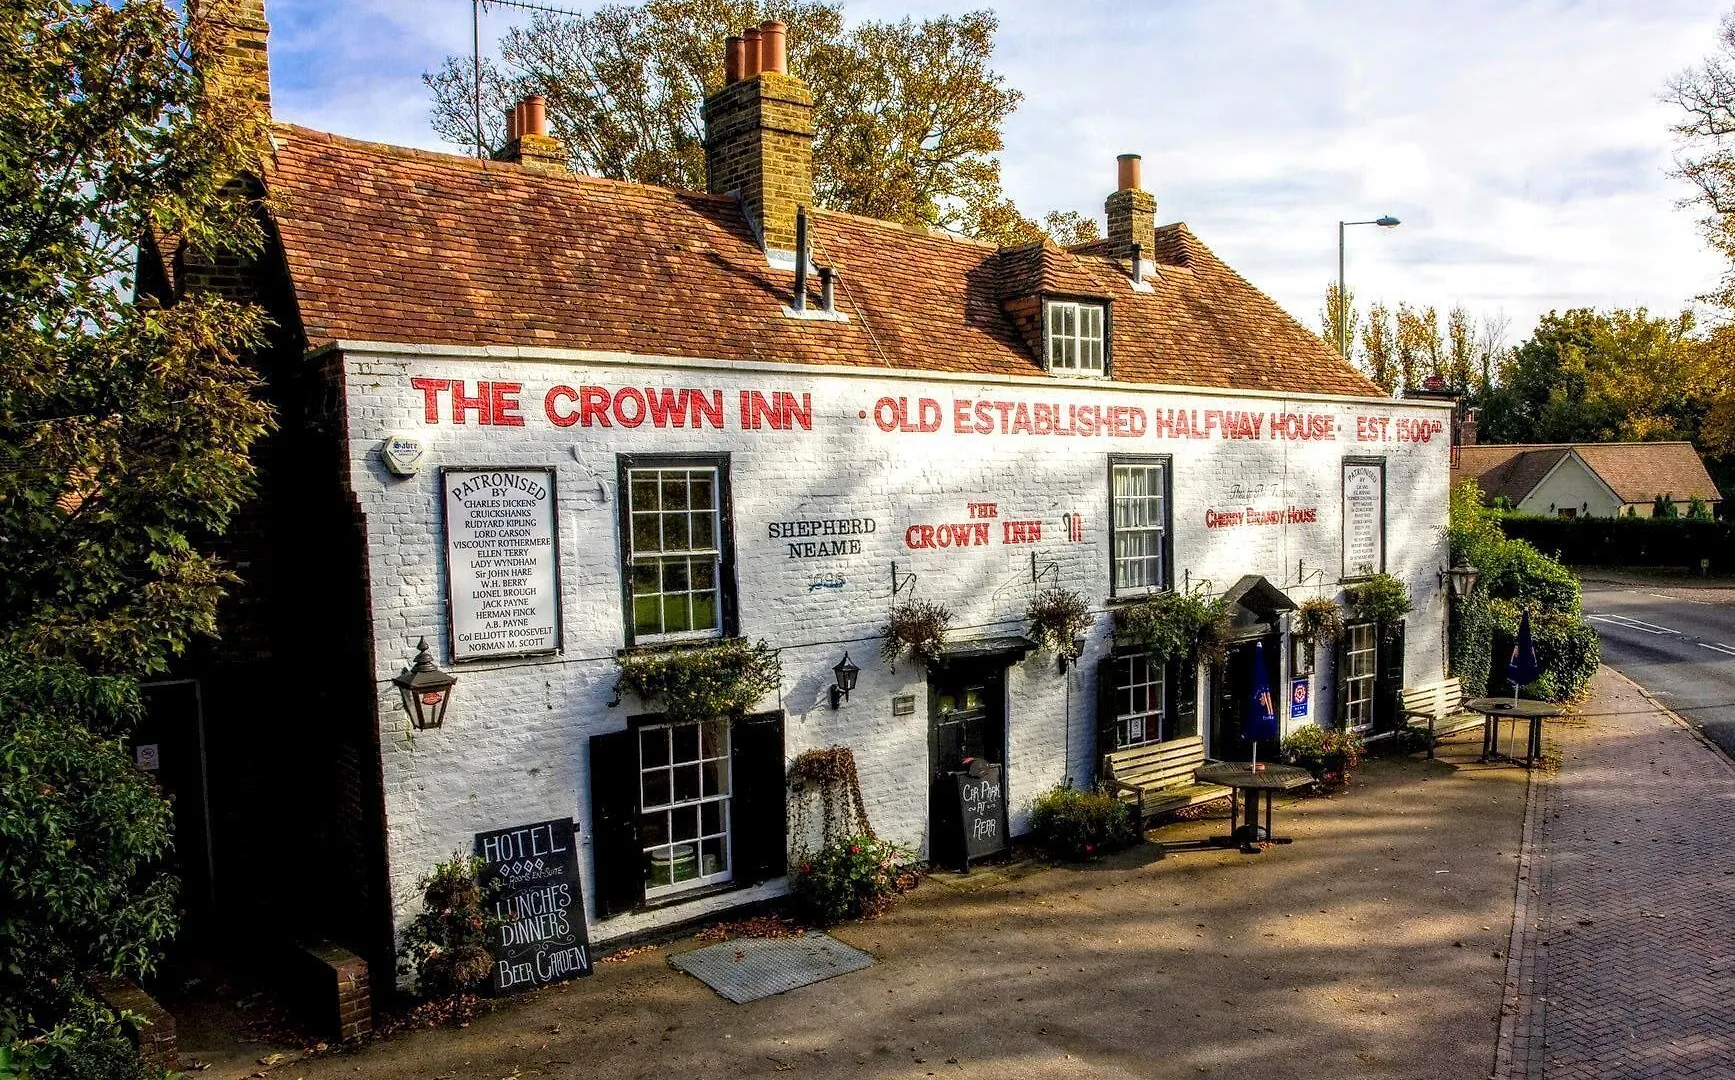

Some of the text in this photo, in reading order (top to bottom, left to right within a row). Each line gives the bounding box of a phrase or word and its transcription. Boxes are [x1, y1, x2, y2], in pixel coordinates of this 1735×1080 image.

[411, 377, 812, 431] THE CROWN INN
[874, 396, 943, 433] OLD
[953, 399, 1147, 437] ESTABLISHED
[1155, 407, 1266, 441] HALFWAY
[1270, 410, 1335, 442] HOUSE
[1357, 416, 1391, 442] EST.
[452, 473, 546, 501] PATRONISED
[492, 488, 508, 497] BY
[464, 499, 536, 509] CHARLES DICKENS
[470, 509, 531, 518] CRUICKSHANKS
[967, 502, 998, 519] THE
[1287, 505, 1317, 524] HOUSE
[465, 518, 537, 529] RUDYARD KIPLING
[768, 518, 876, 539] SHEPHERD
[474, 529, 531, 539] LORD CARSON
[905, 520, 1042, 549] CROWN INN
[453, 538, 551, 549] VISCOUNT ROTHERMERE
[788, 540, 861, 559] NEAME
[477, 549, 529, 558] ELLEN TERRY
[471, 558, 537, 568] LADY WYNDHAM
[488, 570, 509, 580] JOHN
[511, 568, 532, 577] HARE
[503, 578, 528, 587] BERRY
[472, 588, 537, 599] LIONEL BROUGH
[482, 599, 529, 610] JACK PAYNE
[476, 608, 536, 620] HERMAN FINCK
[503, 619, 529, 628] PAYNE
[458, 627, 553, 642] Col ELLIOTT ROOSEVELT
[468, 641, 506, 652] NORMAN
[519, 638, 545, 647] SCOTT
[973, 818, 996, 840] REAR
[484, 824, 567, 863] HOTEL
[501, 909, 570, 947] DINNERS
